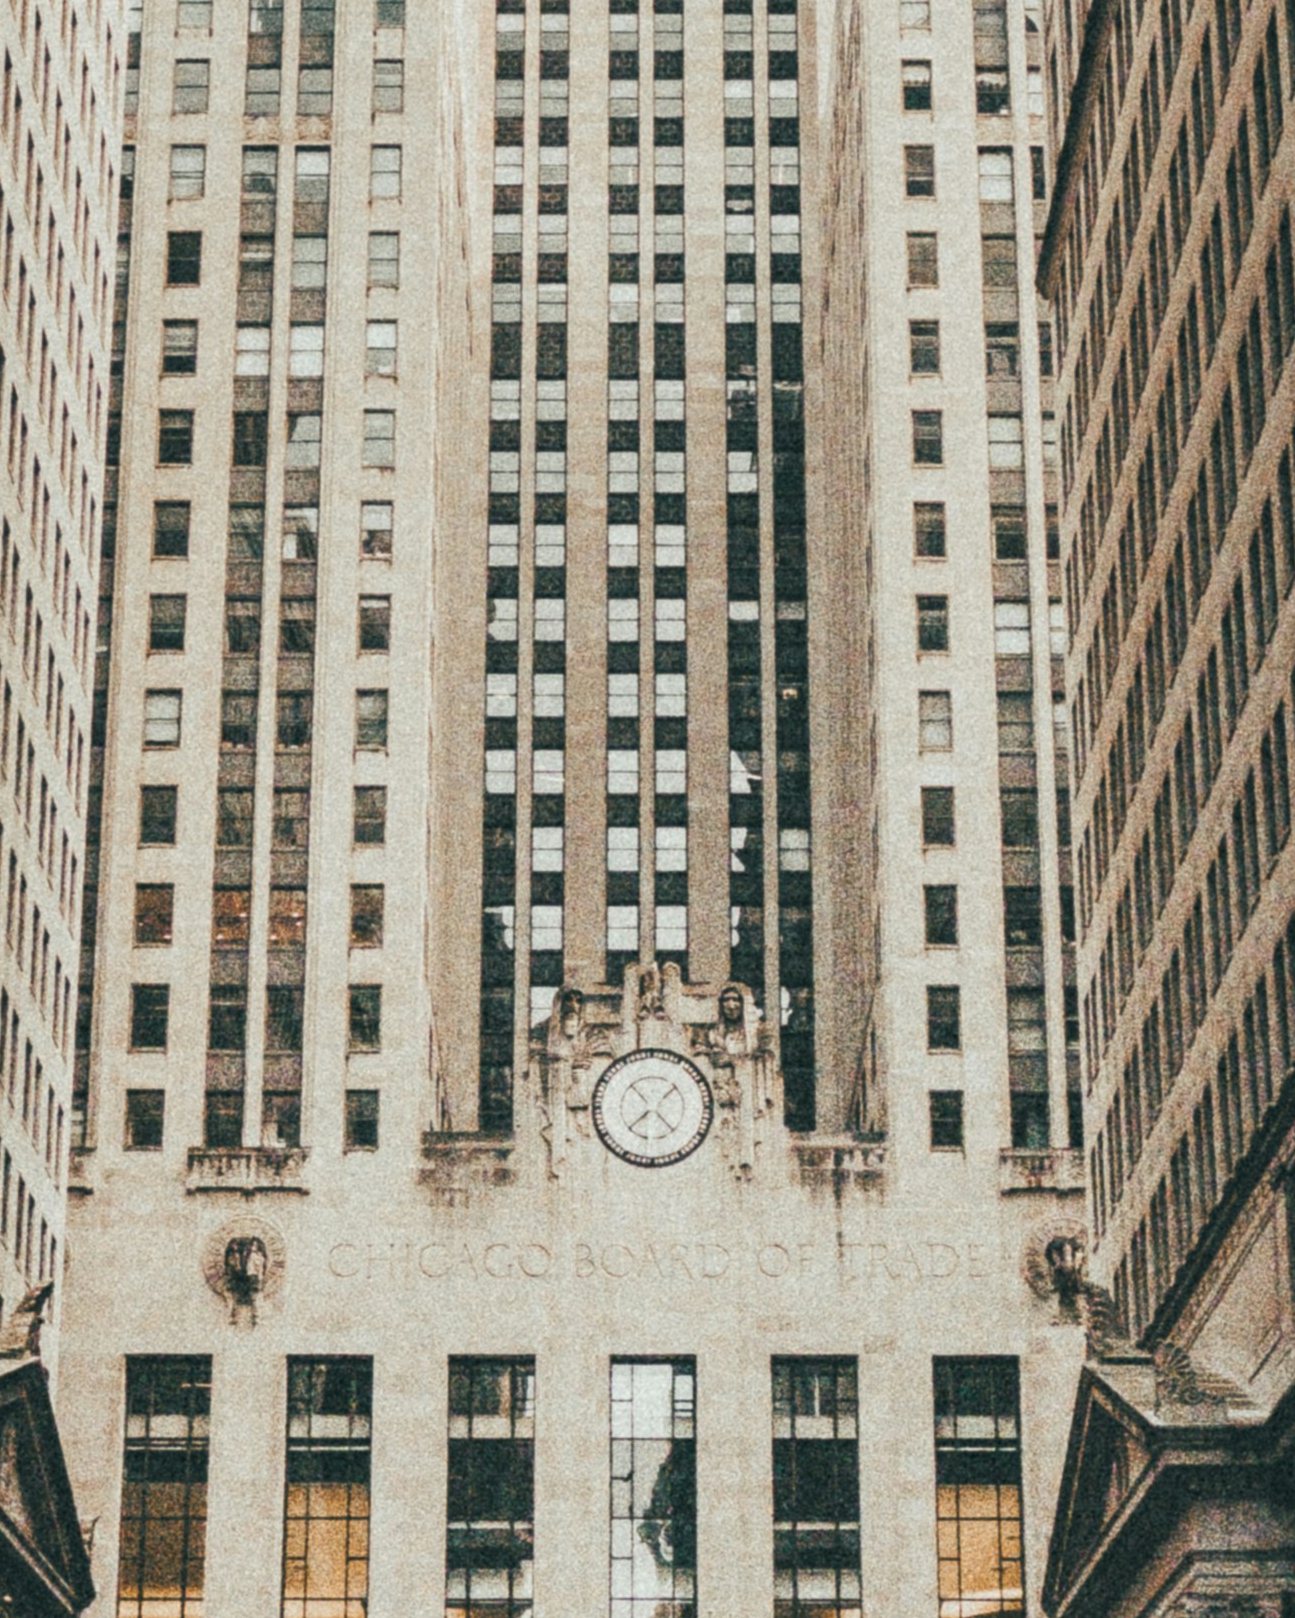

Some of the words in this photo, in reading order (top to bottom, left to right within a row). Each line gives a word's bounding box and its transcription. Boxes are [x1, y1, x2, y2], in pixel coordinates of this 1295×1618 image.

[327, 1241, 552, 1280] CHICAGO
[574, 1241, 731, 1280] BOARD
[757, 1241, 815, 1280] OF
[838, 1241, 989, 1280] TRADE
